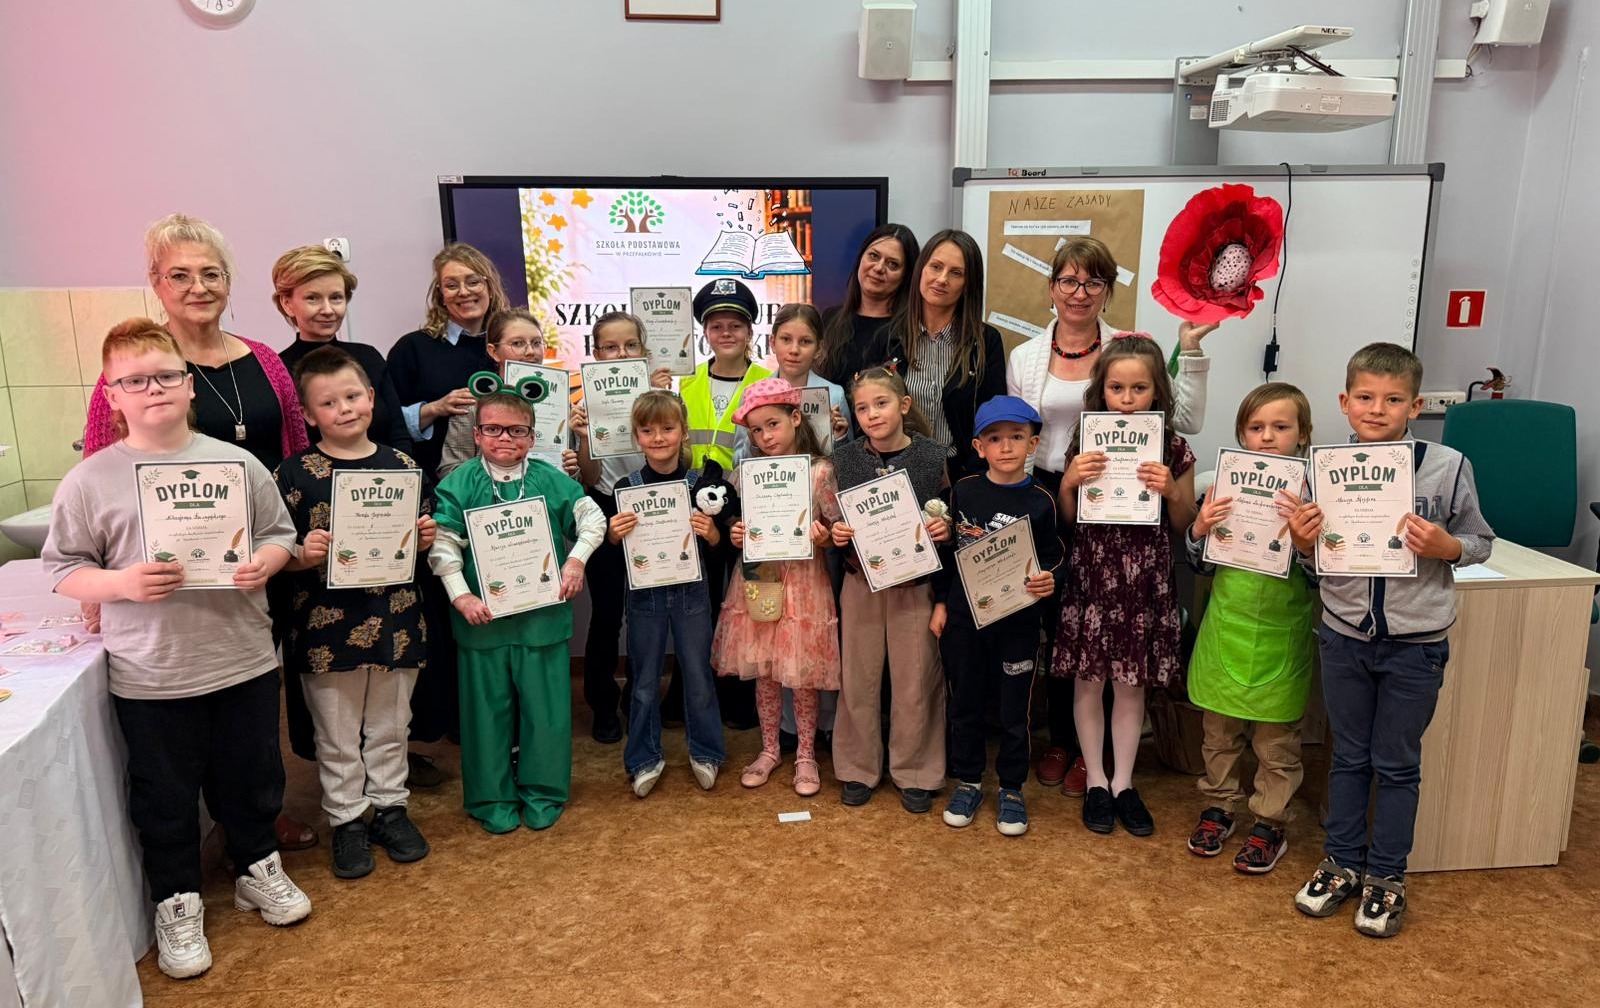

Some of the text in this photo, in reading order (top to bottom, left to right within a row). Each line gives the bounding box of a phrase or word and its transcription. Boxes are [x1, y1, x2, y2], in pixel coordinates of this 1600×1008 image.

[1021, 168, 1047, 176] Board
[1008, 194, 1112, 215] NASZE ZASADY
[596, 241, 681, 249] SZKOŁA PODSTAWOWA
[642, 299, 681, 311] DYPLOM
[594, 376, 639, 391] DYPLOM
[1094, 430, 1149, 446] DYPLOM
[753, 470, 797, 485] DYPLOM
[1230, 471, 1289, 491] DYPLOM
[1329, 465, 1396, 485] DYPLOM
[155, 482, 229, 502] DYPLOM
[351, 486, 405, 502] DYPLOM
[632, 497, 676, 514] DYPLOM
[855, 490, 900, 515] DYPLOM
[484, 516, 533, 536] DYPLOM
[972, 534, 1017, 564] DYPLOM
